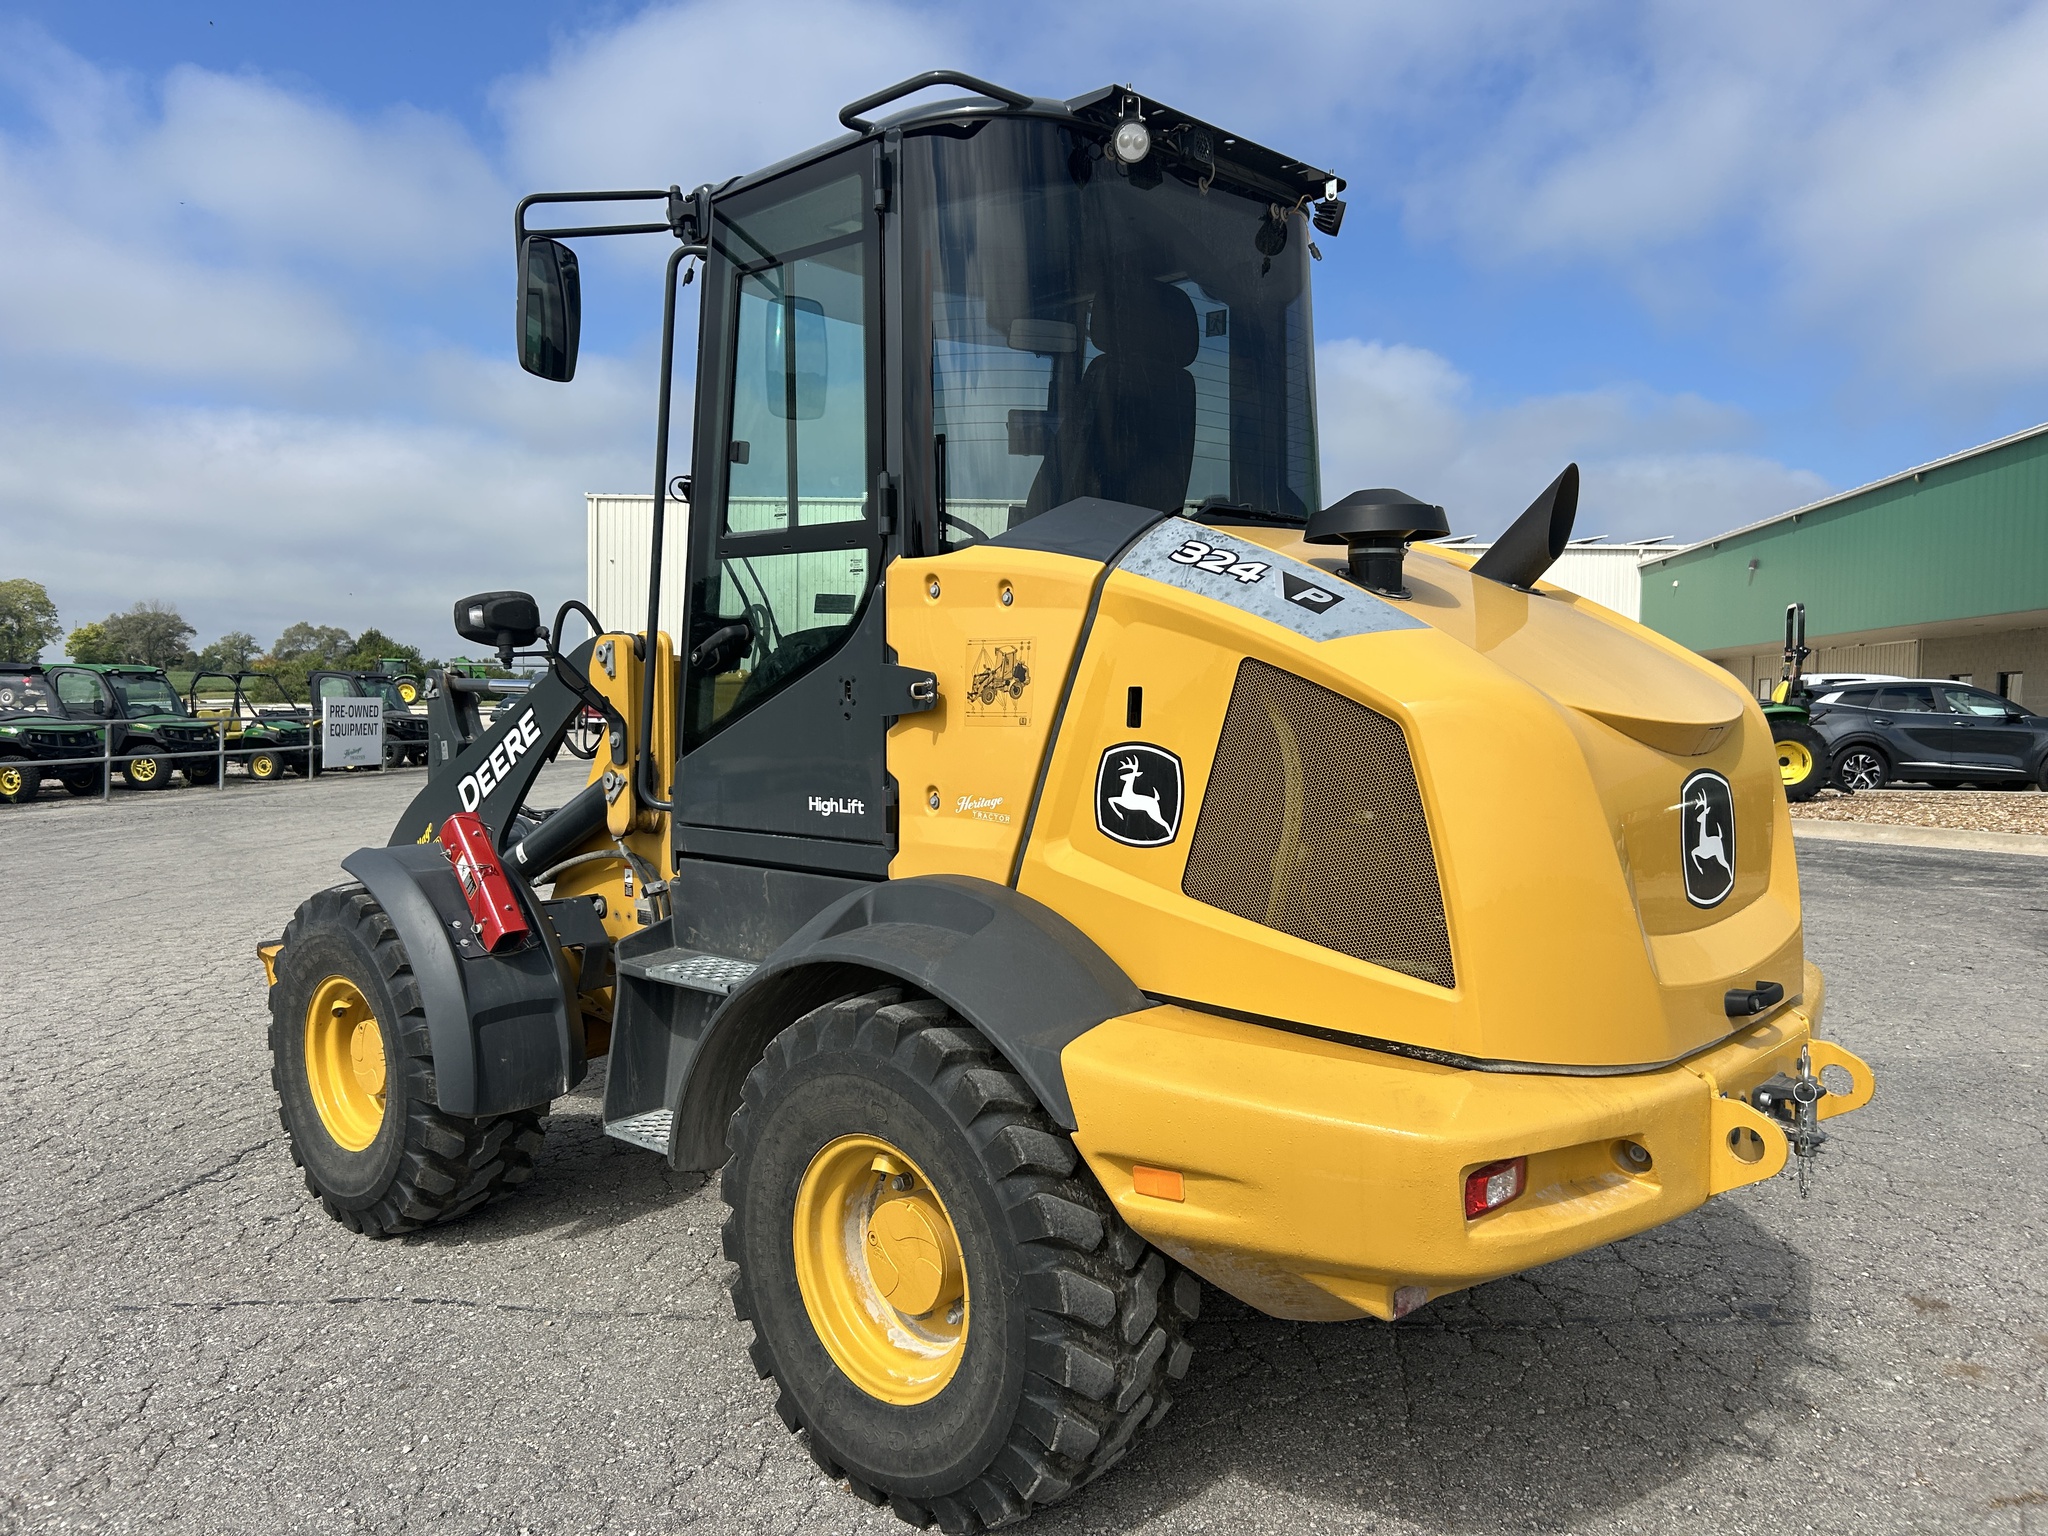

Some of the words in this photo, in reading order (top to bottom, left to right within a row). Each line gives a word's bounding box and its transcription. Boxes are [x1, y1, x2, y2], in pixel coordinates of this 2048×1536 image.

[1169, 540, 1271, 583] 324
[1291, 587, 1333, 603] P
[329, 704, 379, 718] PRE-OWNED
[330, 723, 379, 738] EQUIPMENT
[457, 706, 541, 812] DEERE
[955, 795, 1004, 813] Heritage
[972, 811, 1011, 823] TRACTOR
